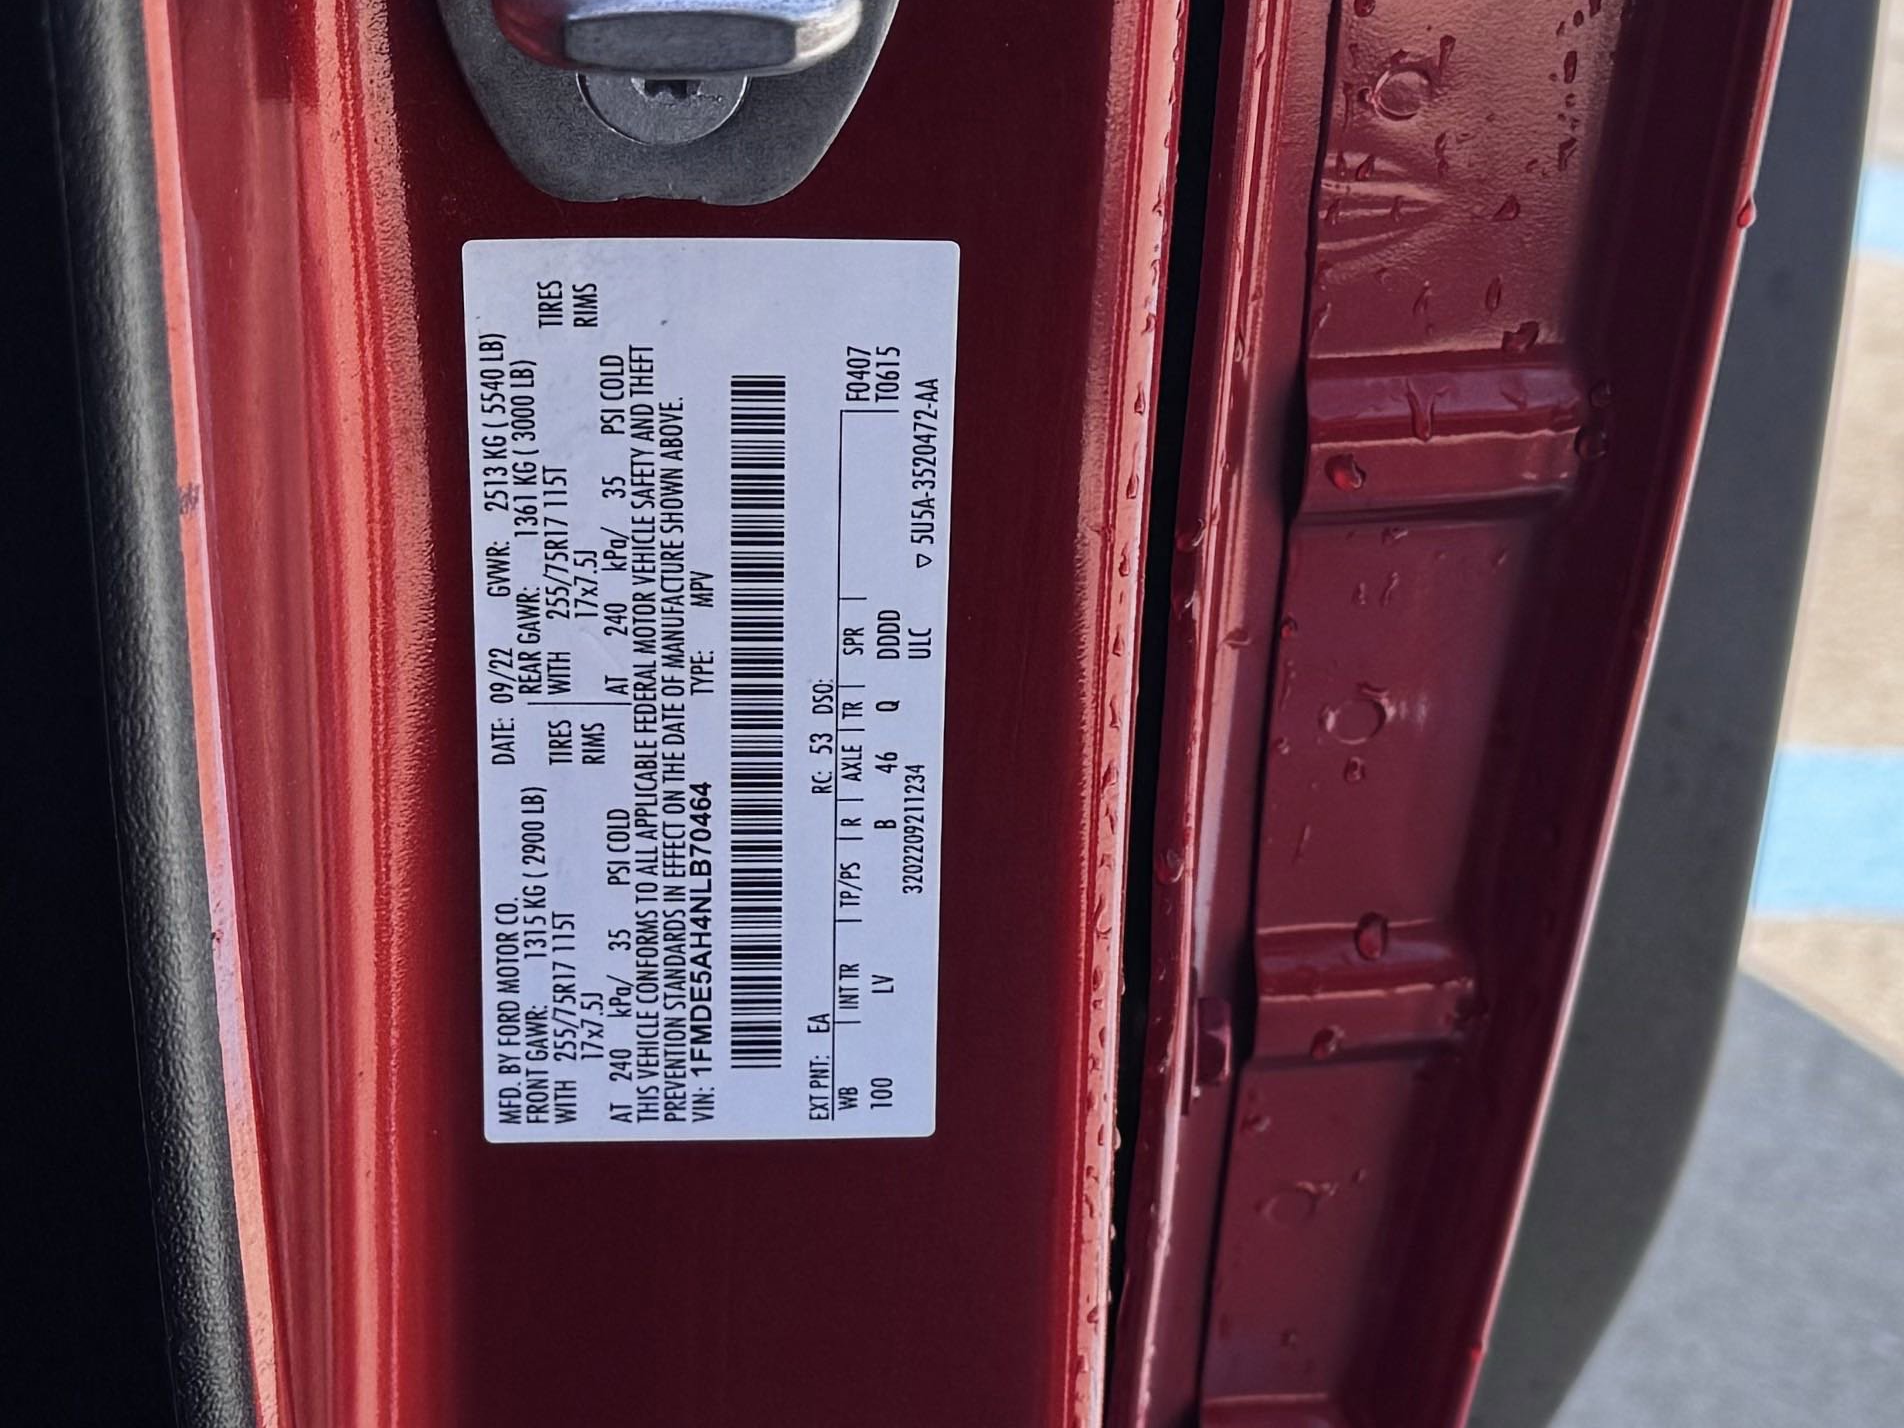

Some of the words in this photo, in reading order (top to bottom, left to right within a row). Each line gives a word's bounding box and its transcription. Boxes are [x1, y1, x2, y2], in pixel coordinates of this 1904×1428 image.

[538, 280, 564, 329] TIRES
[573, 282, 598, 328] RIMS
[600, 354, 624, 401] COLD
[629, 344, 653, 396] THEFT
[846, 345, 871, 401] F0407
[875, 345, 900, 402] T0615
[601, 409, 625, 435] PSI
[630, 403, 654, 442] AND
[659, 397, 683, 461] ABOVE.
[631, 448, 655, 509] SAFETY
[910, 379, 939, 545] 5U5A-3520472-AA
[484, 466, 509, 512] 2513
[542, 465, 567, 507] 115T
[661, 467, 683, 533] SHOWN
[514, 493, 538, 537] 1361
[487, 541, 511, 597] GVWR:
[543, 518, 571, 620] 255/75R17
[601, 526, 628, 571] kPa/
[632, 516, 656, 585] VEHICLE
[573, 550, 598, 619] 17x7.5J
[661, 539, 685, 668] MANUFACTURE
[690, 571, 714, 608] MPV
[516, 586, 541, 644] GAWR:
[604, 602, 628, 636] 240
[633, 592, 656, 654] MOTOR
[877, 610, 901, 659] DDDD
[843, 627, 864, 656] SPR
[908, 628, 932, 659] ULC
[488, 647, 516, 704] 09/22
[518, 651, 542, 694] REAR
[662, 675, 685, 697] OF
[691, 650, 715, 695] TYPE:
[634, 659, 658, 733] FEDERAL
[812, 679, 834, 714] DSO:
[842, 701, 863, 720] TR
[491, 717, 515, 765] DATE:
[549, 720, 573, 765] TIRES
[582, 722, 606, 765] RIMS
[662, 702, 685, 745] DATE
[809, 733, 832, 755] 53
[663, 752, 685, 784] THE
[811, 771, 832, 794] RC:
[841, 744, 862, 782] AXLE
[875, 752, 897, 774] 46
[635, 739, 657, 840] APPLICABLE
[662, 790, 685, 815] ON
[607, 809, 631, 853] COLD
[663, 822, 685, 878] EFFECT
[902, 764, 925, 894] 3202209211234
[607, 860, 631, 885] PSI
[635, 846, 658, 874] ALL
[495, 897, 519, 925] CO.
[635, 883, 658, 904] TO
[664, 885, 686, 902] IN
[522, 915, 547, 959] 1315
[552, 911, 575, 952] 115T
[608, 929, 631, 951] 35
[690, 781, 713, 1078] 1FMDE5AH4NLB70464
[496, 932, 520, 994] MOTOR
[636, 910, 659, 1004] CONFORMS
[664, 909, 687, 1010] STANDARDS
[839, 963, 859, 981] TR
[607, 974, 634, 1017] kPa/
[838, 985, 859, 1009] INT
[872, 974, 894, 994] LV
[497, 1000, 521, 1046] FORD
[524, 1005, 549, 1061] GAWR:
[552, 962, 579, 1062] 255/75R17
[581, 992, 604, 1061] 17x7.5J
[808, 1013, 830, 1033] EA
[498, 1051, 521, 1074] BY
[609, 1048, 632, 1082] 240
[637, 1010, 659, 1079] VEHICLE
[664, 1016, 687, 1122] PREVENTION
[809, 1055, 830, 1089] PNT:
[499, 1081, 522, 1124] MFD.
[526, 1069, 549, 1124] FRONT
[554, 1080, 577, 1124] WITH
[637, 1085, 659, 1123] THIS
[693, 1086, 715, 1122] VIN:
[809, 1095, 830, 1120] EXT
[870, 1077, 893, 1110] 100
